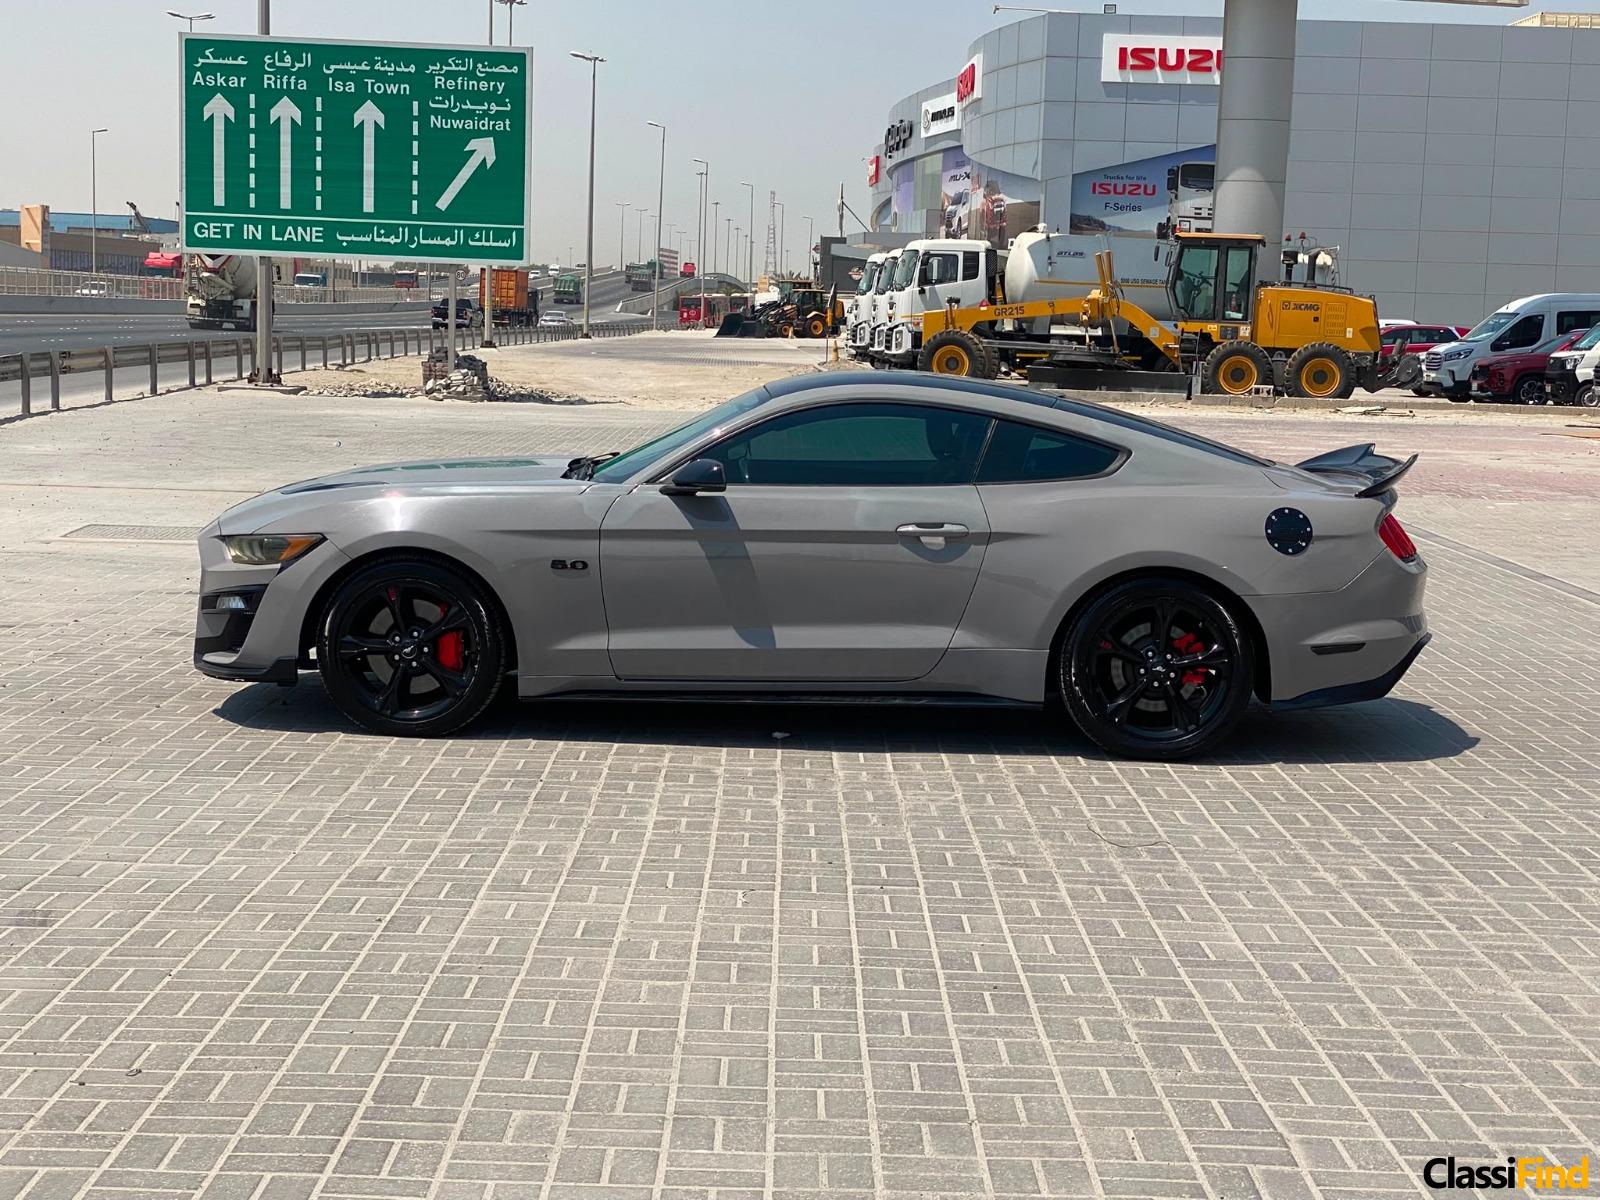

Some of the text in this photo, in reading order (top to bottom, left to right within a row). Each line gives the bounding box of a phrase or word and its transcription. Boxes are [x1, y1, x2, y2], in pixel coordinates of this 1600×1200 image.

[193, 48, 249, 68] عسكر
[263, 50, 312, 71] الرفاع
[322, 56, 416, 75] مدينة عيسى
[424, 57, 519, 77] مصنع التكرير
[1118, 46, 1223, 73] ISUZ
[192, 71, 247, 88] Askar
[263, 74, 307, 90] Riffa
[328, 77, 410, 95] Isa Town
[434, 76, 506, 95] Refinery
[429, 95, 512, 113] نويدرات
[430, 115, 511, 132] Nuwaidrat
[1091, 182, 1157, 196] ISUZU
[1104, 202, 1142, 212] F-Series
[193, 222, 325, 243] GET IN LANE
[336, 225, 516, 248] اسلك المسار المناسب
[994, 307, 1025, 317] GR215
[1291, 303, 1320, 311] XCMG
